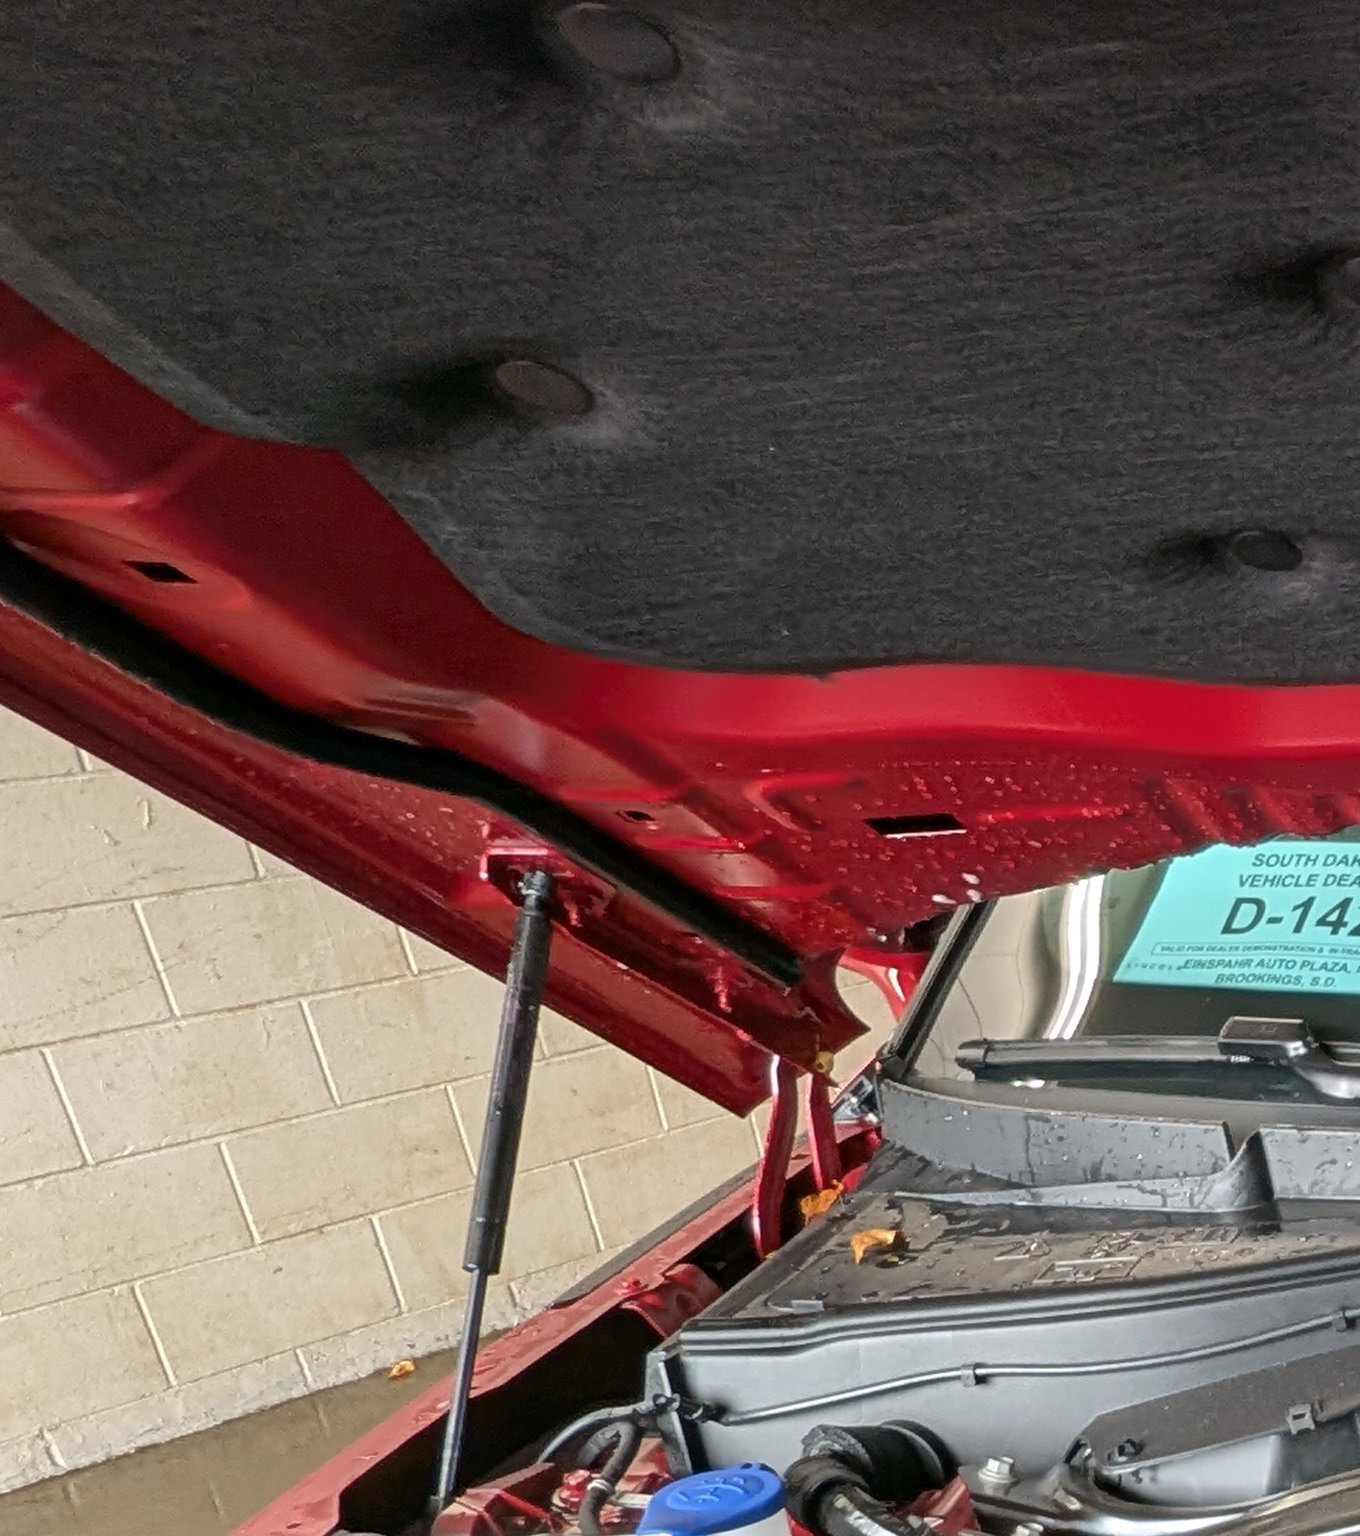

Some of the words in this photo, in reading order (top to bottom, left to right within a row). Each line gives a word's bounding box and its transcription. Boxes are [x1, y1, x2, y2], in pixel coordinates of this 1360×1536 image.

[1252, 853, 1319, 868] SOUTH
[1239, 874, 1319, 888] VEHICLE
[1186, 945, 1204, 953] FOR
[1205, 945, 1240, 953] DEALER
[1242, 945, 1315, 954] DEMONSTRATION
[1182, 959, 1253, 970] EINSPAHR
[1254, 959, 1296, 970] AUTO
[1299, 960, 1350, 974] PLAZA,
[1215, 973, 1304, 986] BROOKINGS,
[1310, 976, 1337, 988] S.D.
